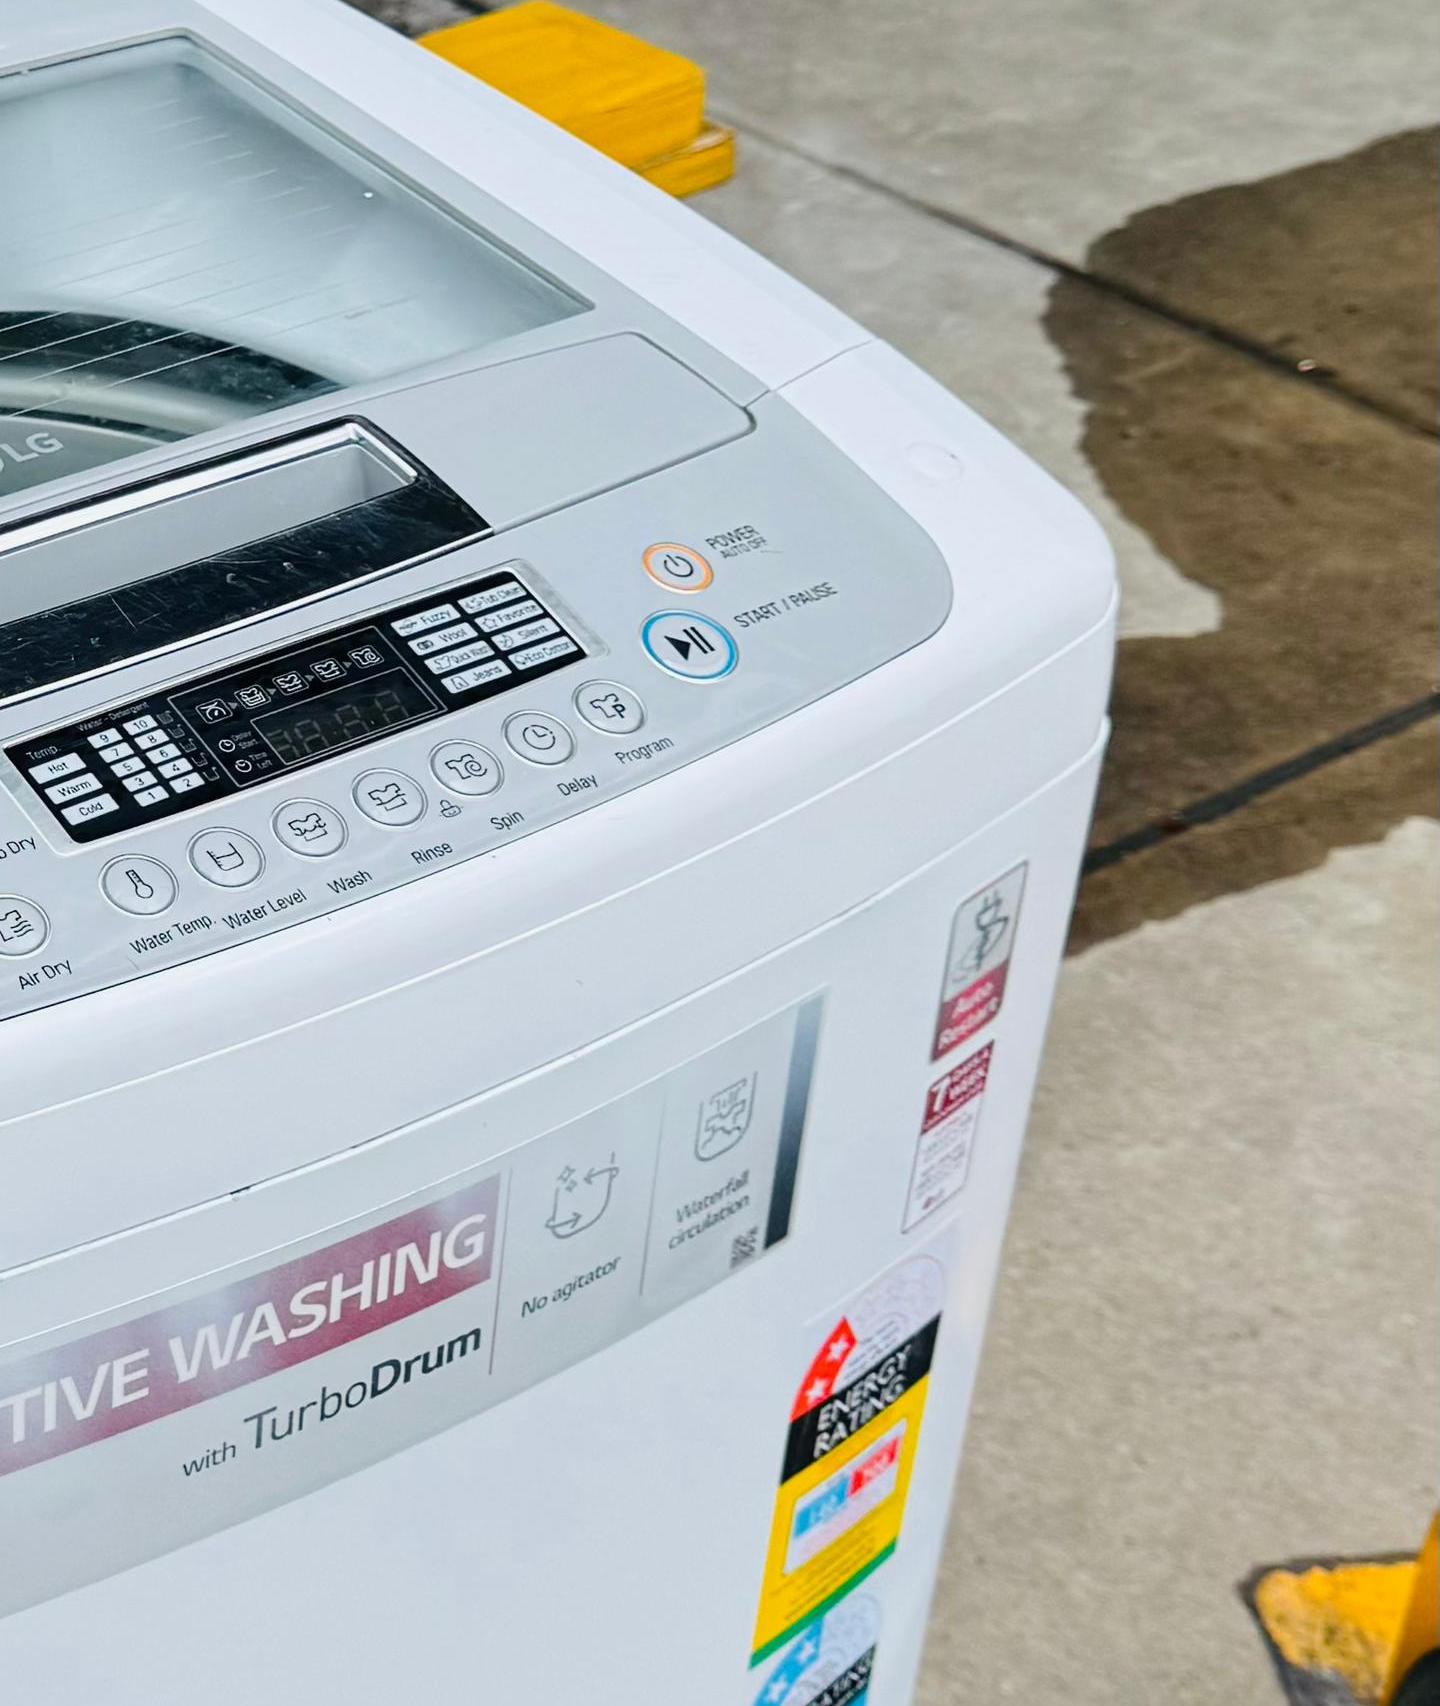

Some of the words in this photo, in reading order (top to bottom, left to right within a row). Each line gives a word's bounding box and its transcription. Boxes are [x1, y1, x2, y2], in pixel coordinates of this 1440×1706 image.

[705, 525, 760, 550] POWER
[497, 604, 539, 623] Favorite
[734, 602, 781, 628] START
[788, 581, 839, 607] PAUSE
[420, 608, 453, 626] Fuzzy
[438, 628, 467, 643] Wool
[472, 666, 503, 682] Jeans
[134, 719, 149, 730] 10
[101, 734, 109, 743] 9
[147, 734, 158, 745] 8
[112, 748, 121, 757] 7
[160, 749, 170, 759] 6
[614, 735, 676, 765] Program
[47, 759, 70, 773] Hot
[123, 763, 133, 772] 5
[171, 763, 182, 774] 4
[57, 778, 93, 798] Warm
[134, 777, 145, 787] 3
[182, 778, 192, 788] 2
[556, 773, 599, 797] Delay
[489, 810, 526, 832] Spin
[5, 836, 37, 854] Dry
[410, 842, 454, 865] Rinse
[325, 869, 373, 894] Wash
[222, 902, 269, 930] Water
[266, 888, 309, 912] Level
[128, 927, 176, 955] Water
[172, 915, 218, 937] Temp.
[18, 971, 41, 991] Air
[40, 959, 73, 980] Dry
[675, 1169, 751, 1224] Waterfall
[668, 1195, 752, 1250] circulation
[167, 1212, 488, 1384] WASHING
[520, 1294, 550, 1319] No
[550, 1256, 622, 1304] agitator
[816, 1343, 912, 1432] ENERGY
[181, 1442, 238, 1477] with
[242, 1327, 482, 1450] TurboDrum
[812, 1373, 909, 1460] RATING
